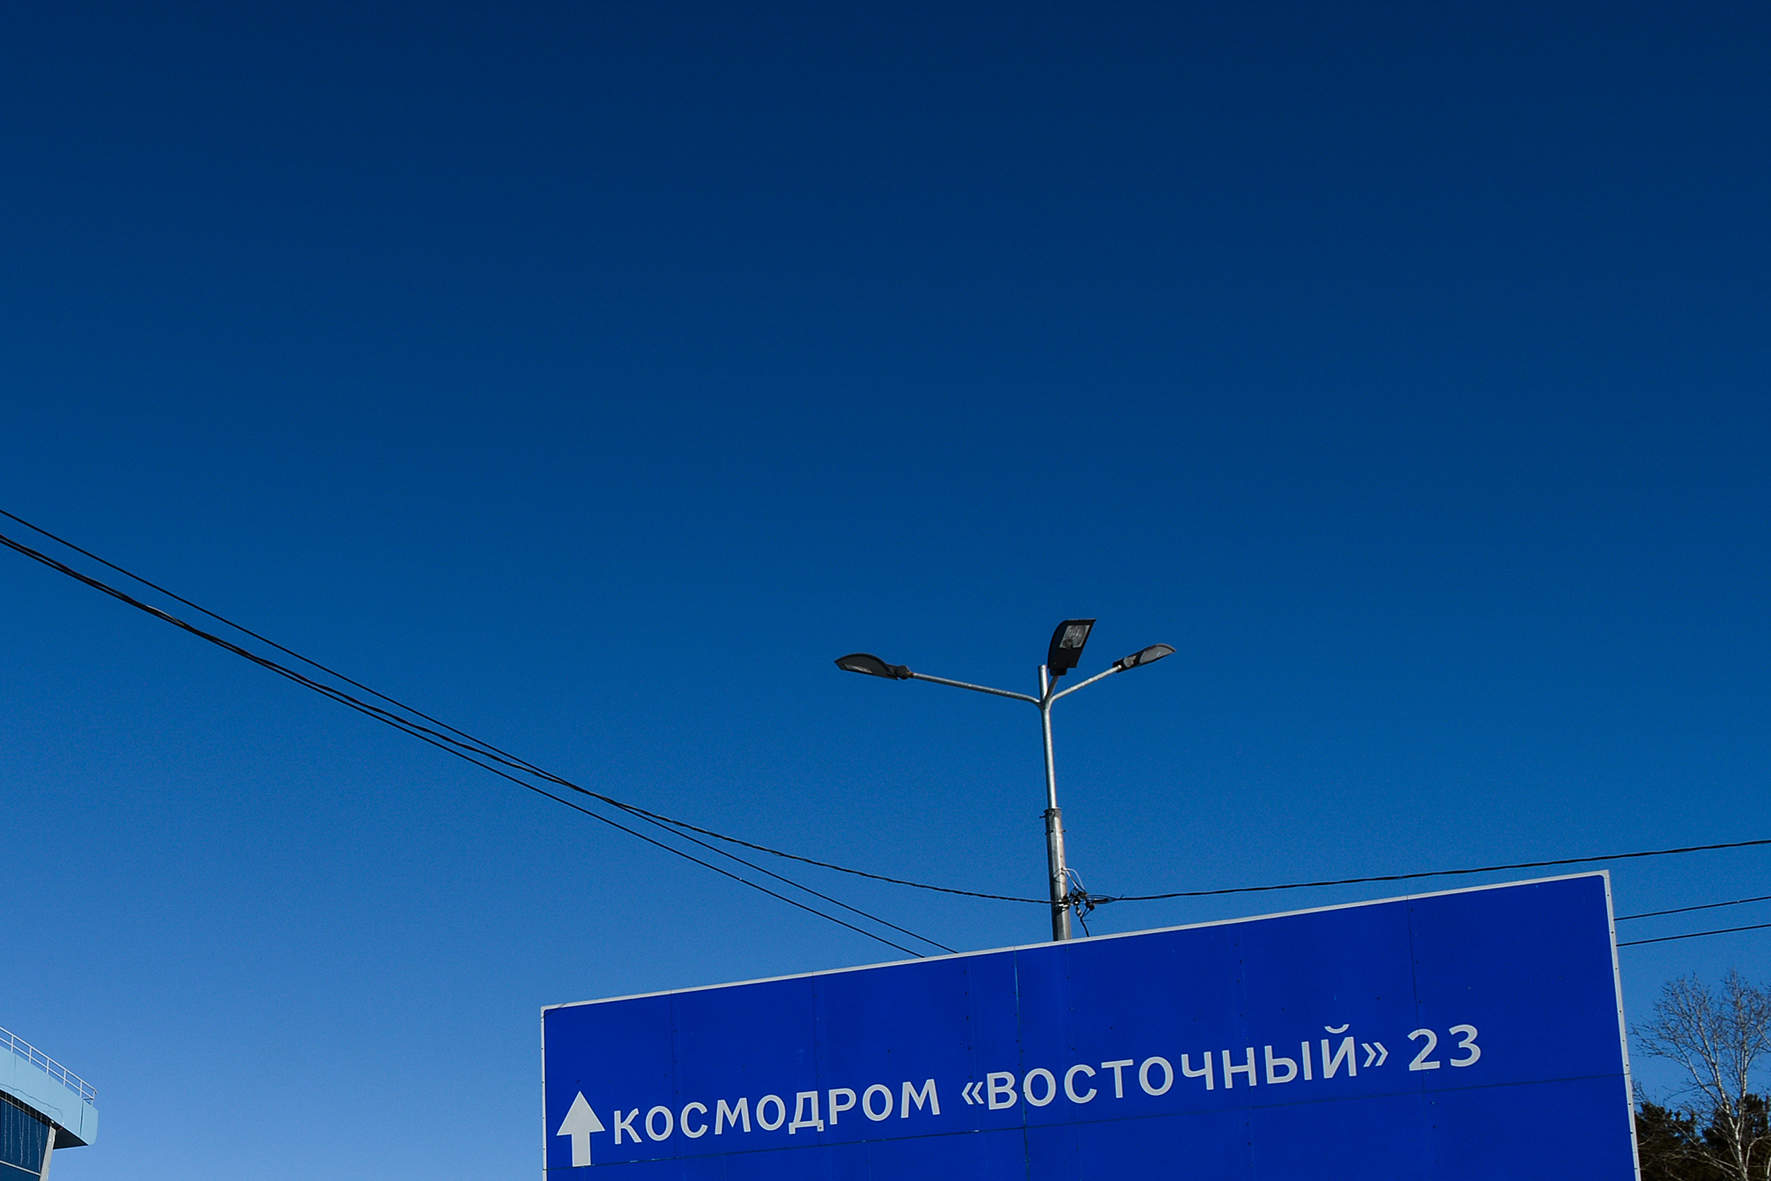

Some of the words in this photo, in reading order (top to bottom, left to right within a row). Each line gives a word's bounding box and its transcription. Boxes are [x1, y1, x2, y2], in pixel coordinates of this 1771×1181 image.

[613, 1079, 941, 1145] КОСМОДРОМ
[961, 1023, 1389, 1110] «ВОСТОЧНЫЙ»
[1407, 1024, 1481, 1071] 23
